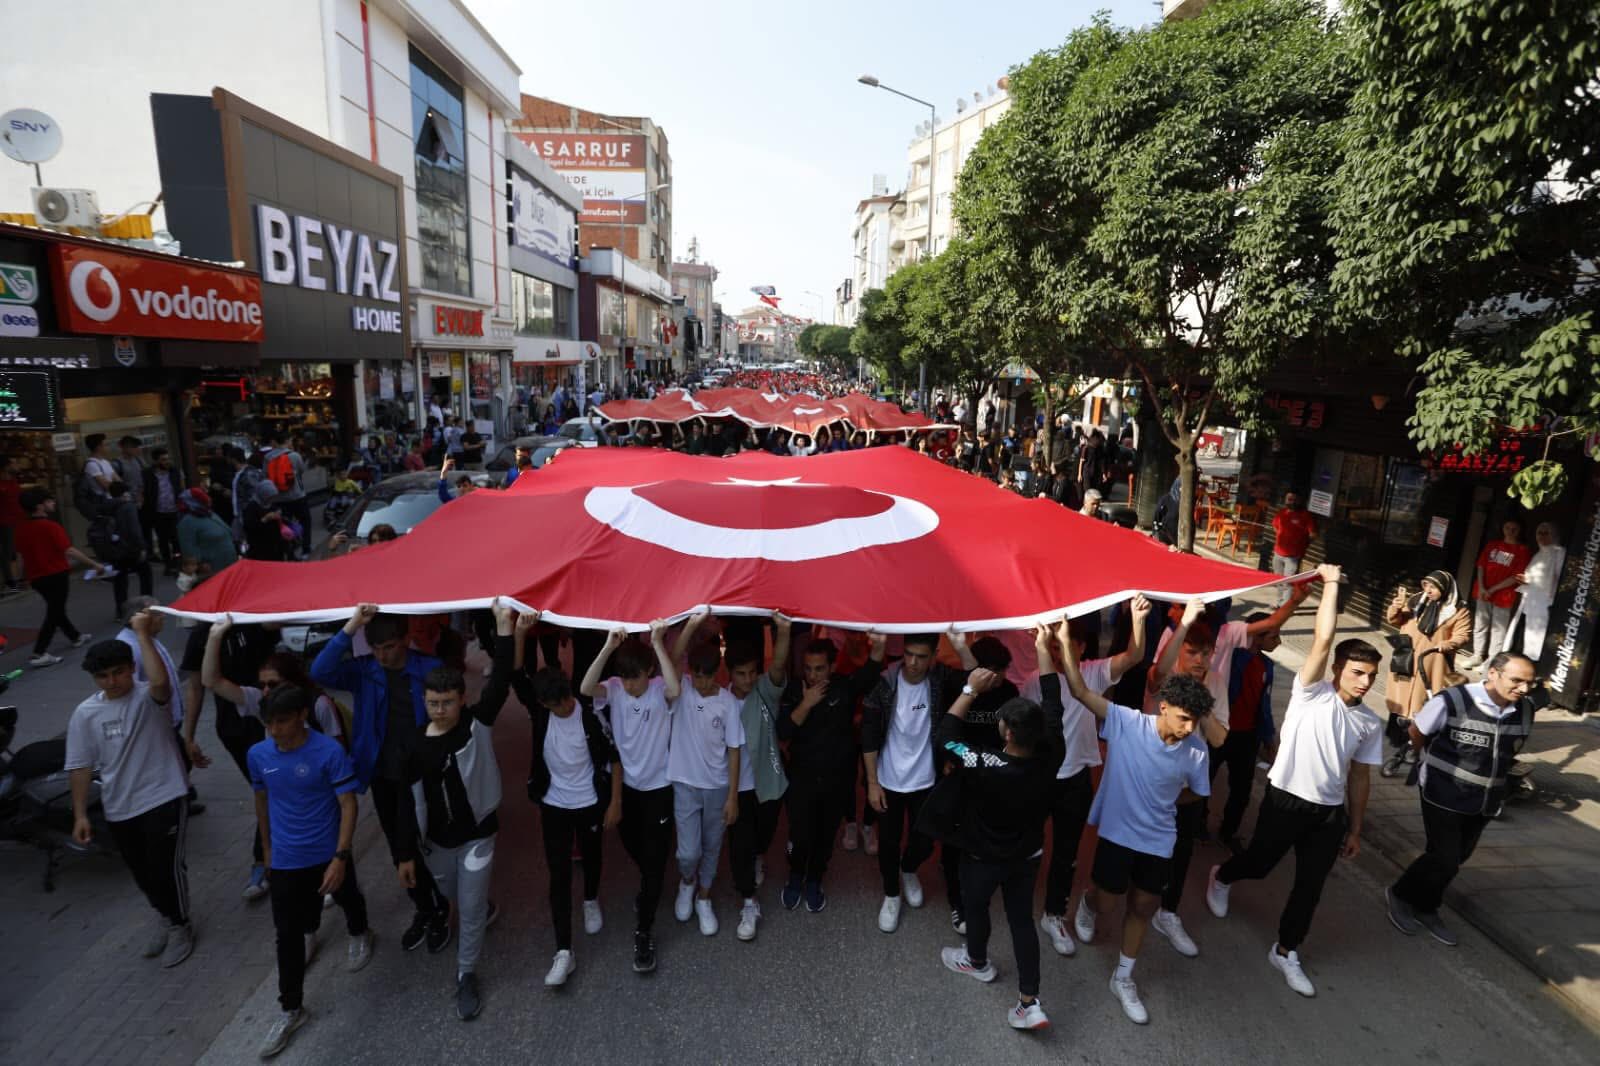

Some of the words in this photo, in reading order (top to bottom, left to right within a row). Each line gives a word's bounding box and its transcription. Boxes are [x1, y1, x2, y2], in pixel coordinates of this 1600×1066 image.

[10, 119, 50, 133] SNY
[521, 141, 632, 158] ASARRUF
[257, 204, 400, 303] BEYAZ
[130, 286, 262, 325] vodafone
[353, 306, 402, 333] HOME
[1550, 617, 1581, 693] Menülerde
